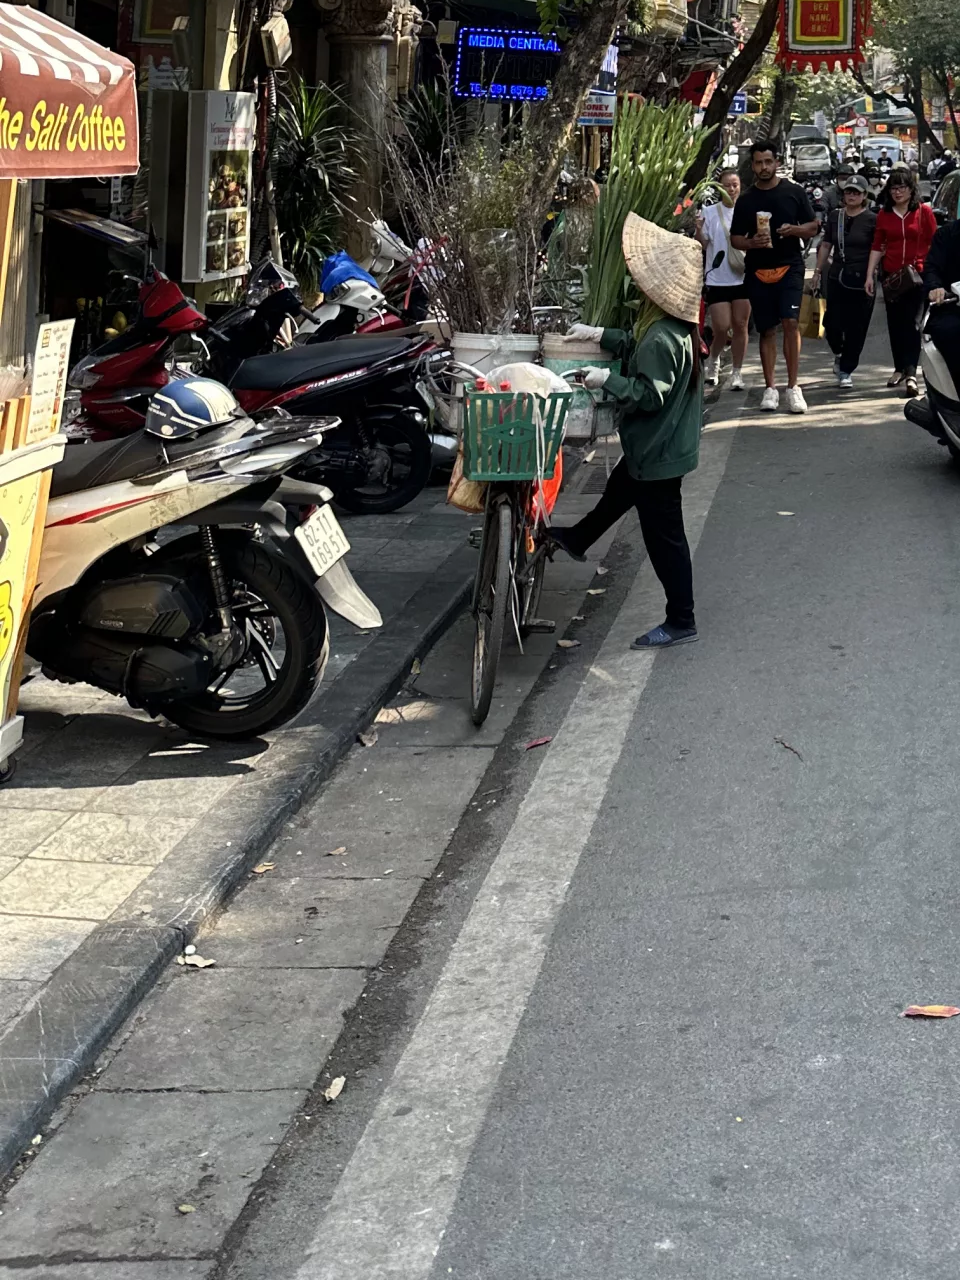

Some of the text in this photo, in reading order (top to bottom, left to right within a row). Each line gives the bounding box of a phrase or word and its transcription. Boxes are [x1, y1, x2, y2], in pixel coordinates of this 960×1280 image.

[468, 33, 505, 48] MEDIA
[26, 100, 69, 152] Salt
[67, 104, 126, 152] Coffee
